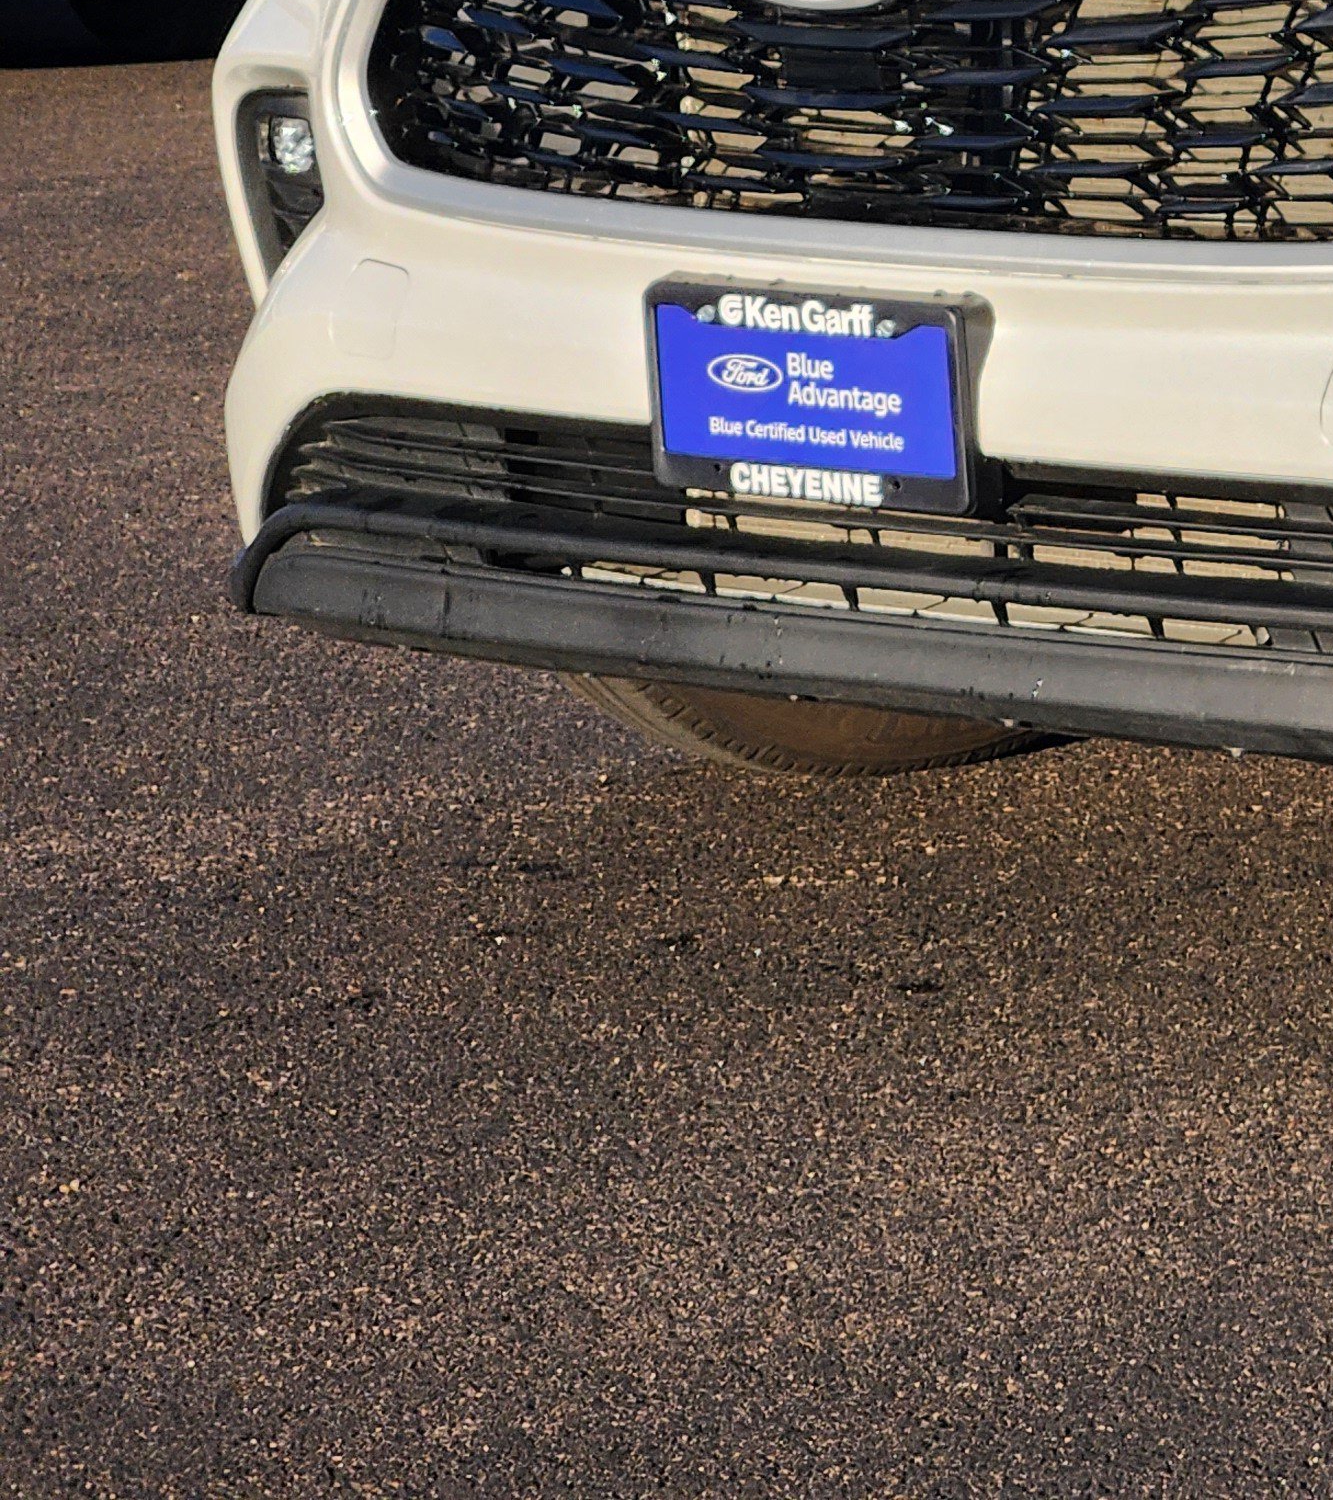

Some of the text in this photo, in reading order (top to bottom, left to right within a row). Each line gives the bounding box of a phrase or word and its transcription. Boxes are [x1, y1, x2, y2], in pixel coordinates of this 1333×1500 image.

[746, 296, 875, 337] Ken Garff
[721, 359, 770, 387] Ford
[785, 352, 835, 380] Blue
[787, 381, 902, 417] Advantage
[708, 416, 905, 451] Blue Certified Used Vehicle
[730, 462, 884, 506] CHEYENNE
